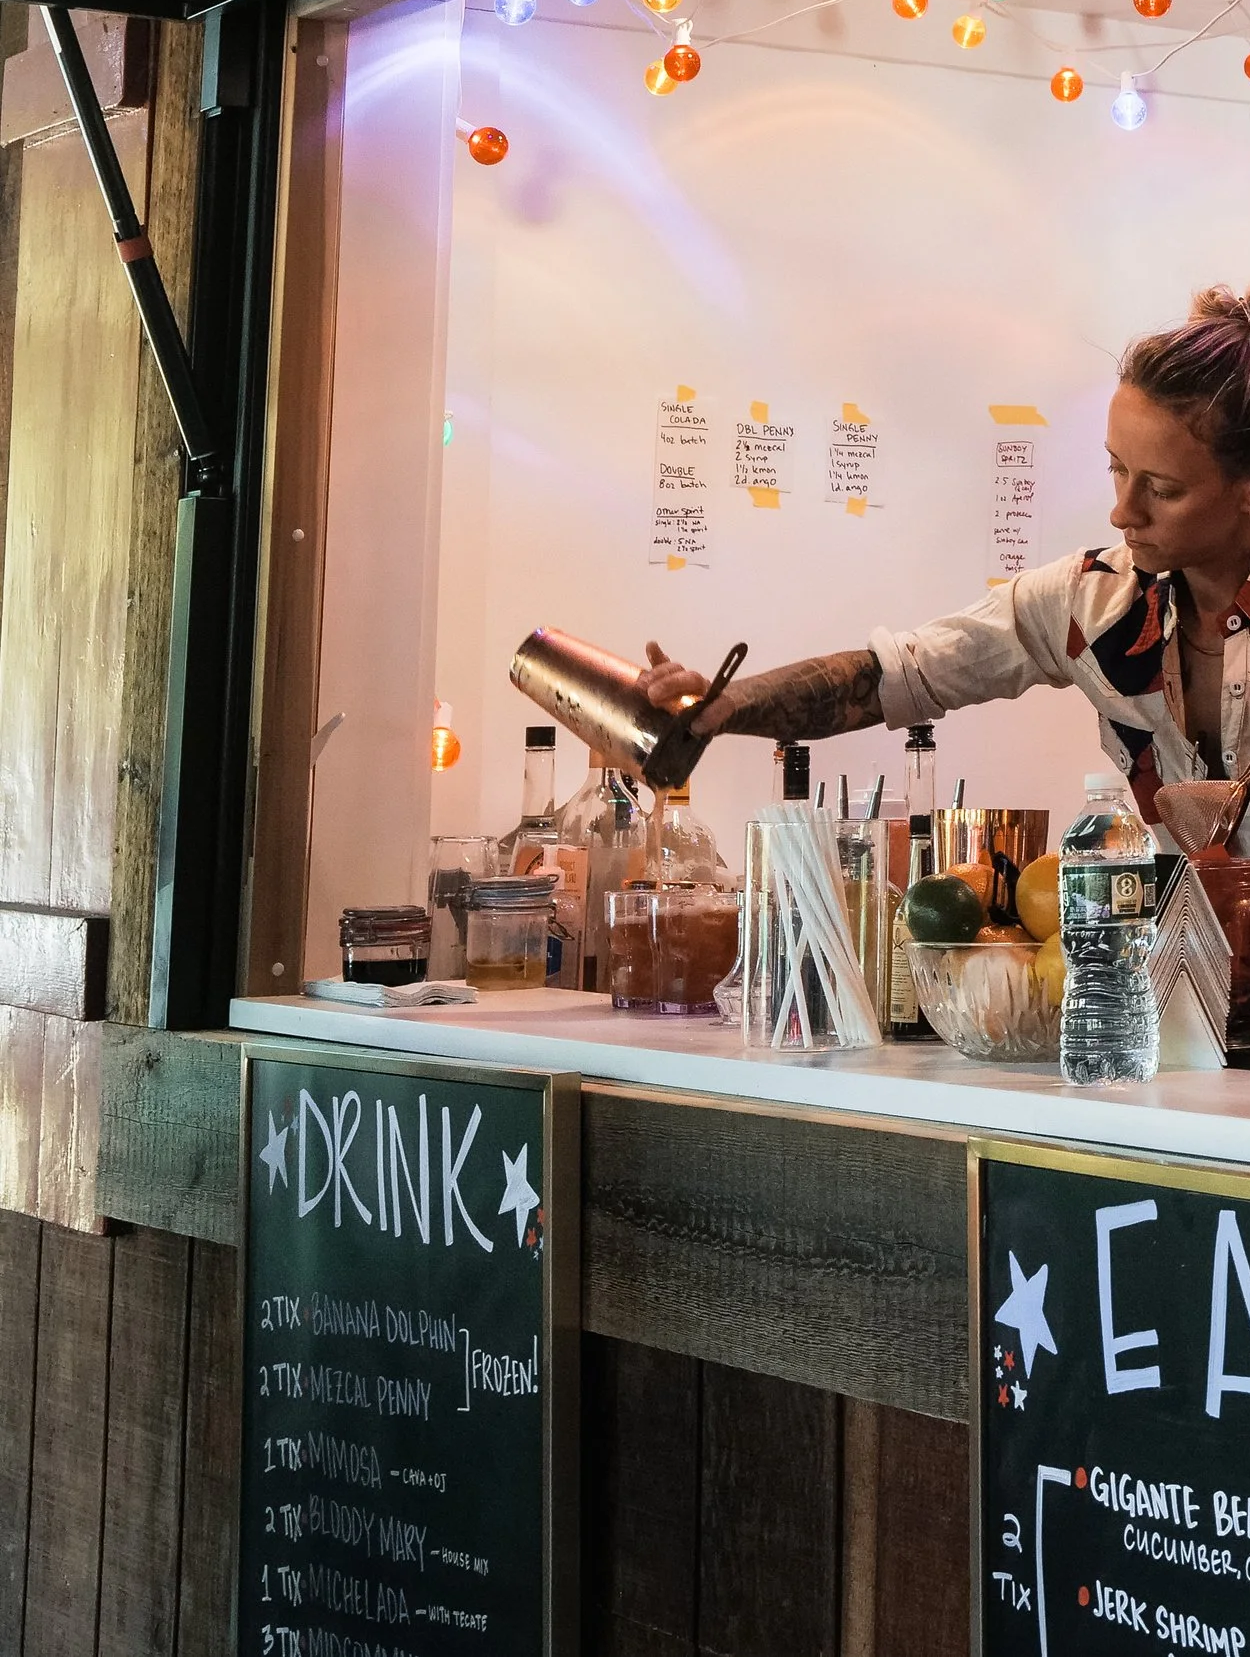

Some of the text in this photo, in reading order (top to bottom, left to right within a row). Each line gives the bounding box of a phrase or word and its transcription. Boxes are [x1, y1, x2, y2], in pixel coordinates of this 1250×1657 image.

[661, 401, 694, 413] SINGLE
[670, 415, 706, 424] COLADA
[736, 423, 794, 437] DBL PENNY
[833, 420, 868, 433] SINGLE
[846, 433, 878, 443] PENNY
[299, 1088, 494, 1253] DRINK
[261, 1292, 456, 1353] 2 TIX BANANA DOLPHIN
[259, 1362, 431, 1421] 2 TIX MEZCAL PENNY
[472, 1334, 538, 1396] FROZEN!
[264, 1437, 276, 1473] 1
[276, 1437, 302, 1471] TIX
[308, 1430, 382, 1489] MIMOSA
[1089, 1466, 1200, 1529] GIGANTE
[265, 1506, 276, 1533] 2
[309, 1493, 375, 1558] BLOODY
[379, 1515, 427, 1572] MARY
[1002, 1513, 1023, 1554] 2
[1123, 1523, 1242, 1580] CUCUMBER,
[261, 1564, 272, 1603] 1
[308, 1562, 411, 1626] MICHELADA
[992, 1571, 1031, 1612] TIX
[1093, 1579, 1150, 1634] JERK
[1155, 1604, 1247, 1657] SHRIMP
[261, 1624, 275, 1656] 3
